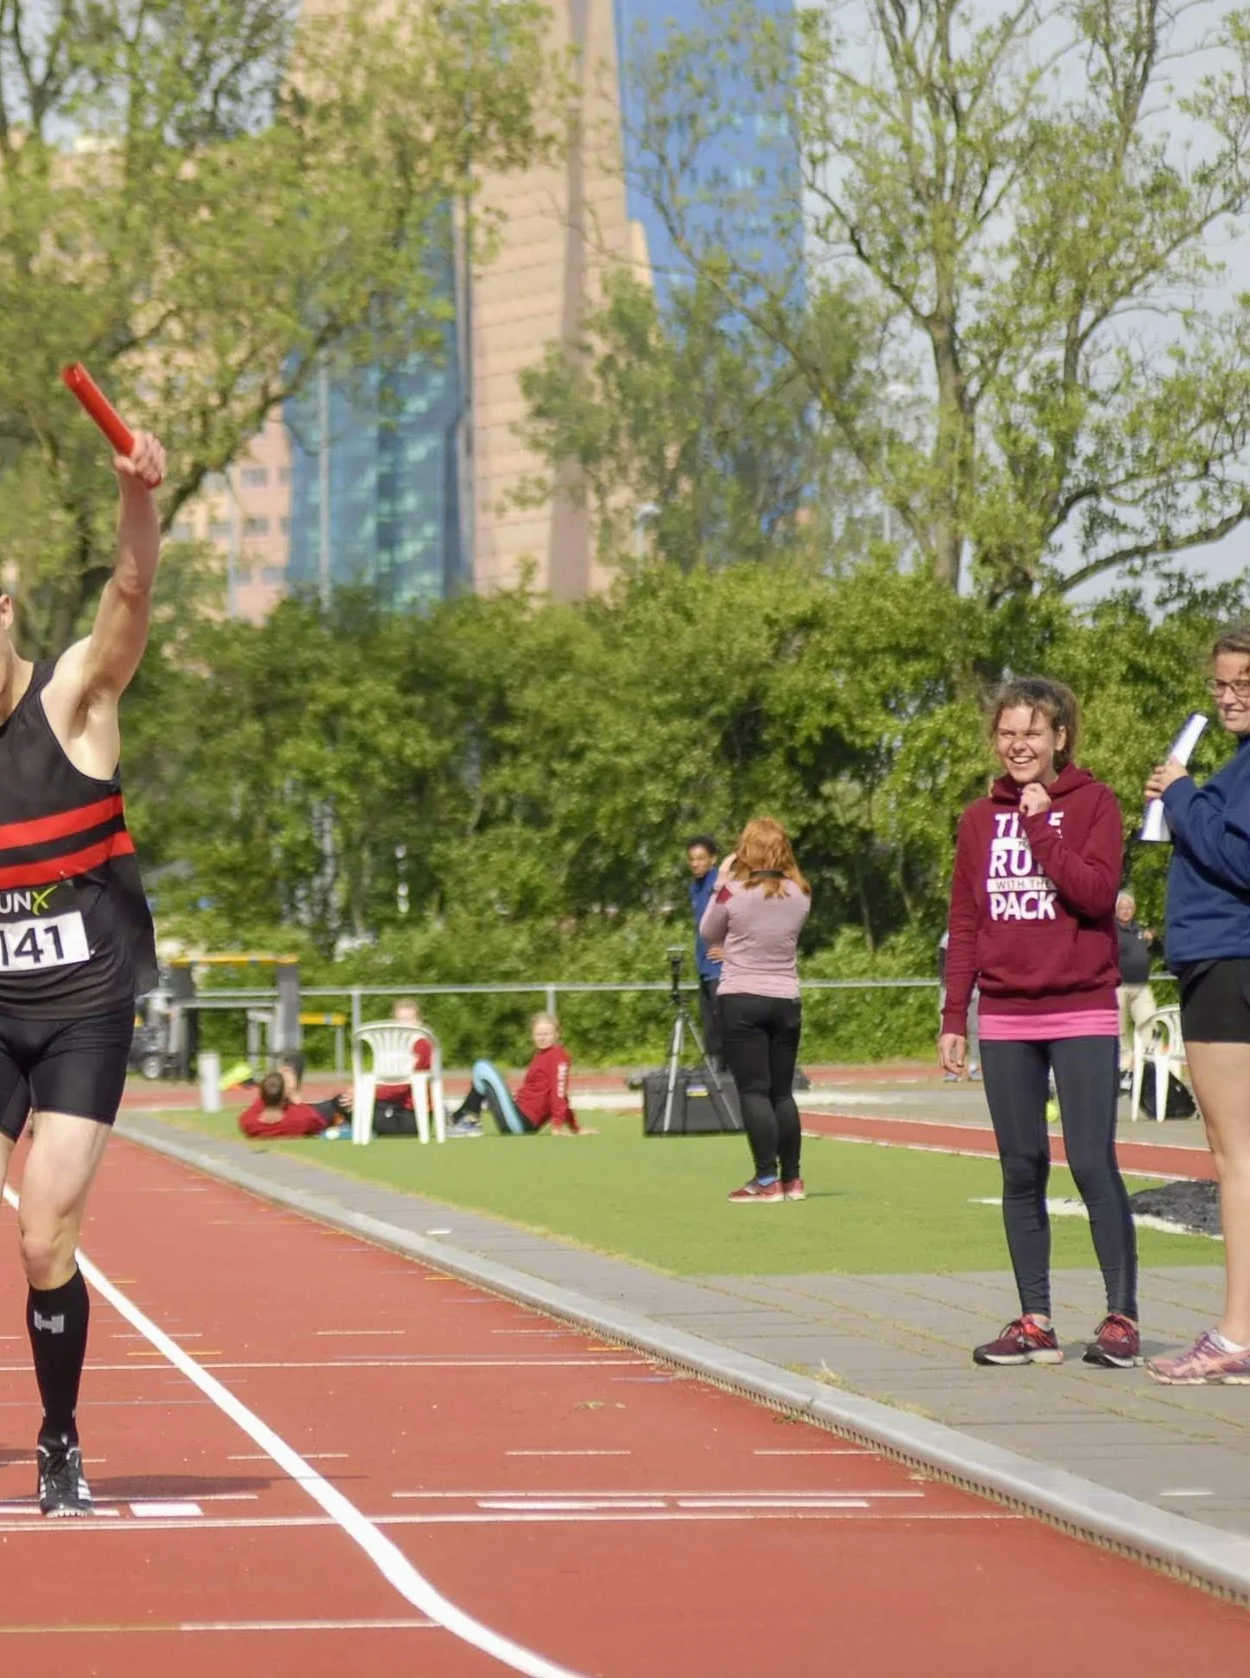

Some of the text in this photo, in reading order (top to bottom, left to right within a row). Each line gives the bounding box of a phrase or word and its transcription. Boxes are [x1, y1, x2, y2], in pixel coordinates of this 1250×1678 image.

[994, 811, 1065, 839] TIE
[989, 849, 1045, 878] RU
[996, 880, 1025, 890] WITH
[990, 890, 1057, 921] PACK
